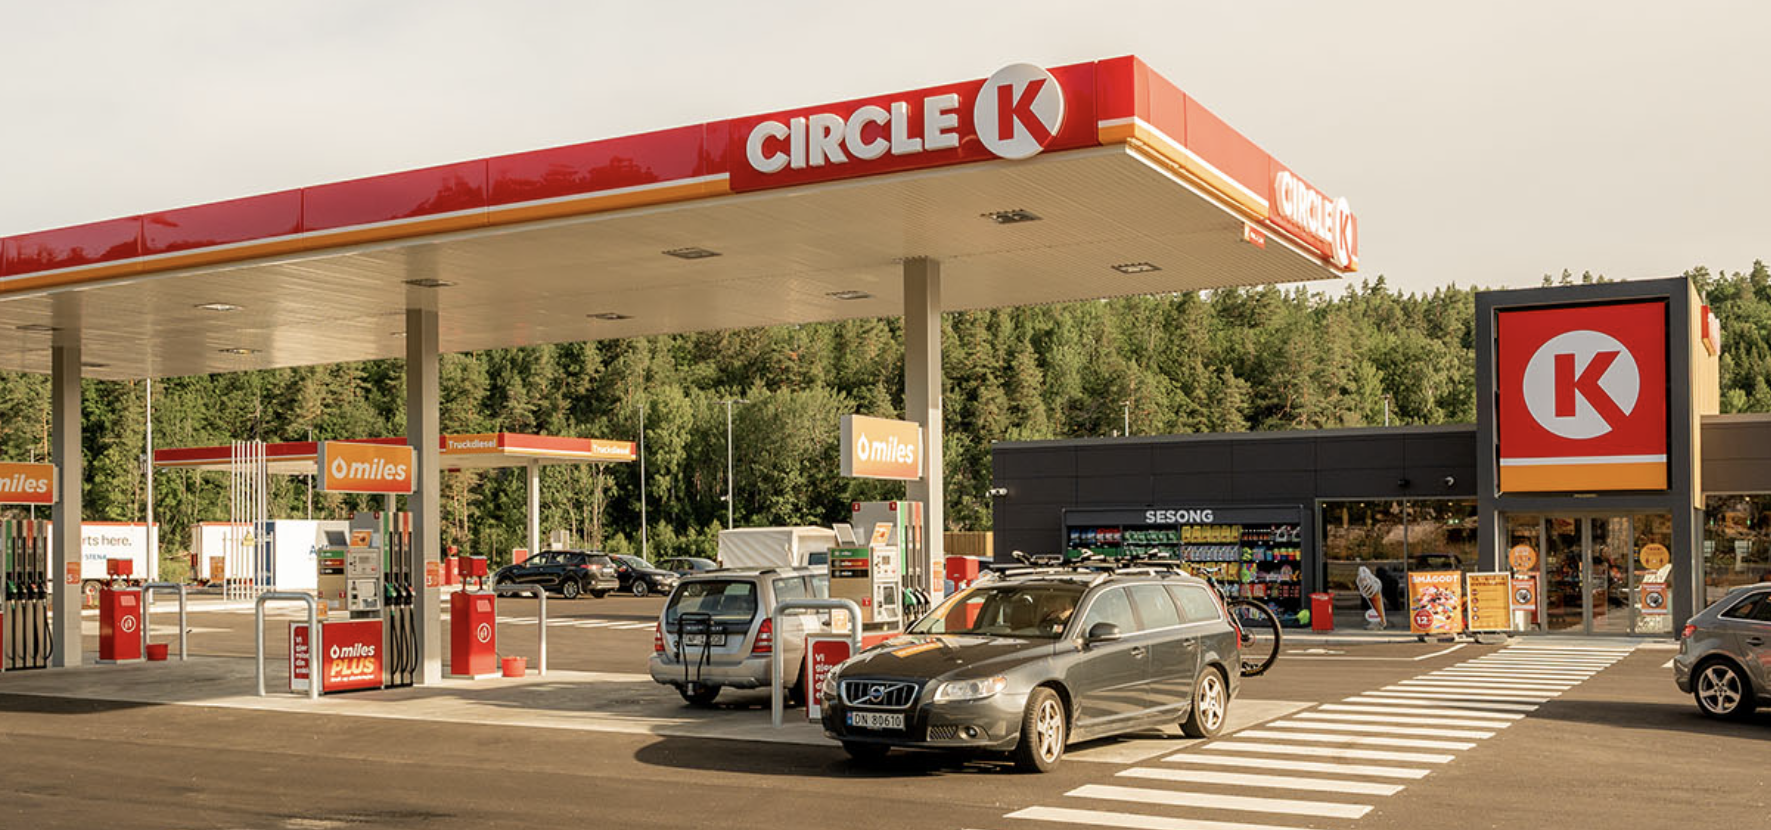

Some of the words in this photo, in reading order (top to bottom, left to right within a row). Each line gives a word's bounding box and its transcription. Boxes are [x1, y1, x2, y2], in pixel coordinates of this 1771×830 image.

[746, 93, 960, 173] CIRCLE
[995, 76, 1055, 152] K
[1274, 170, 1334, 243] CIRCLE
[1552, 348, 1631, 433] K
[448, 438, 496, 449] Truckdiesel
[871, 435, 915, 464] miles
[349, 458, 407, 480] miles
[1145, 509, 1214, 523] SESONG
[101, 534, 132, 546] here.
[341, 643, 375, 657] miles
[815, 653, 825, 662] Vi
[330, 657, 375, 677] PLUS
[854, 713, 868, 725] DN
[871, 714, 902, 727] 80610
